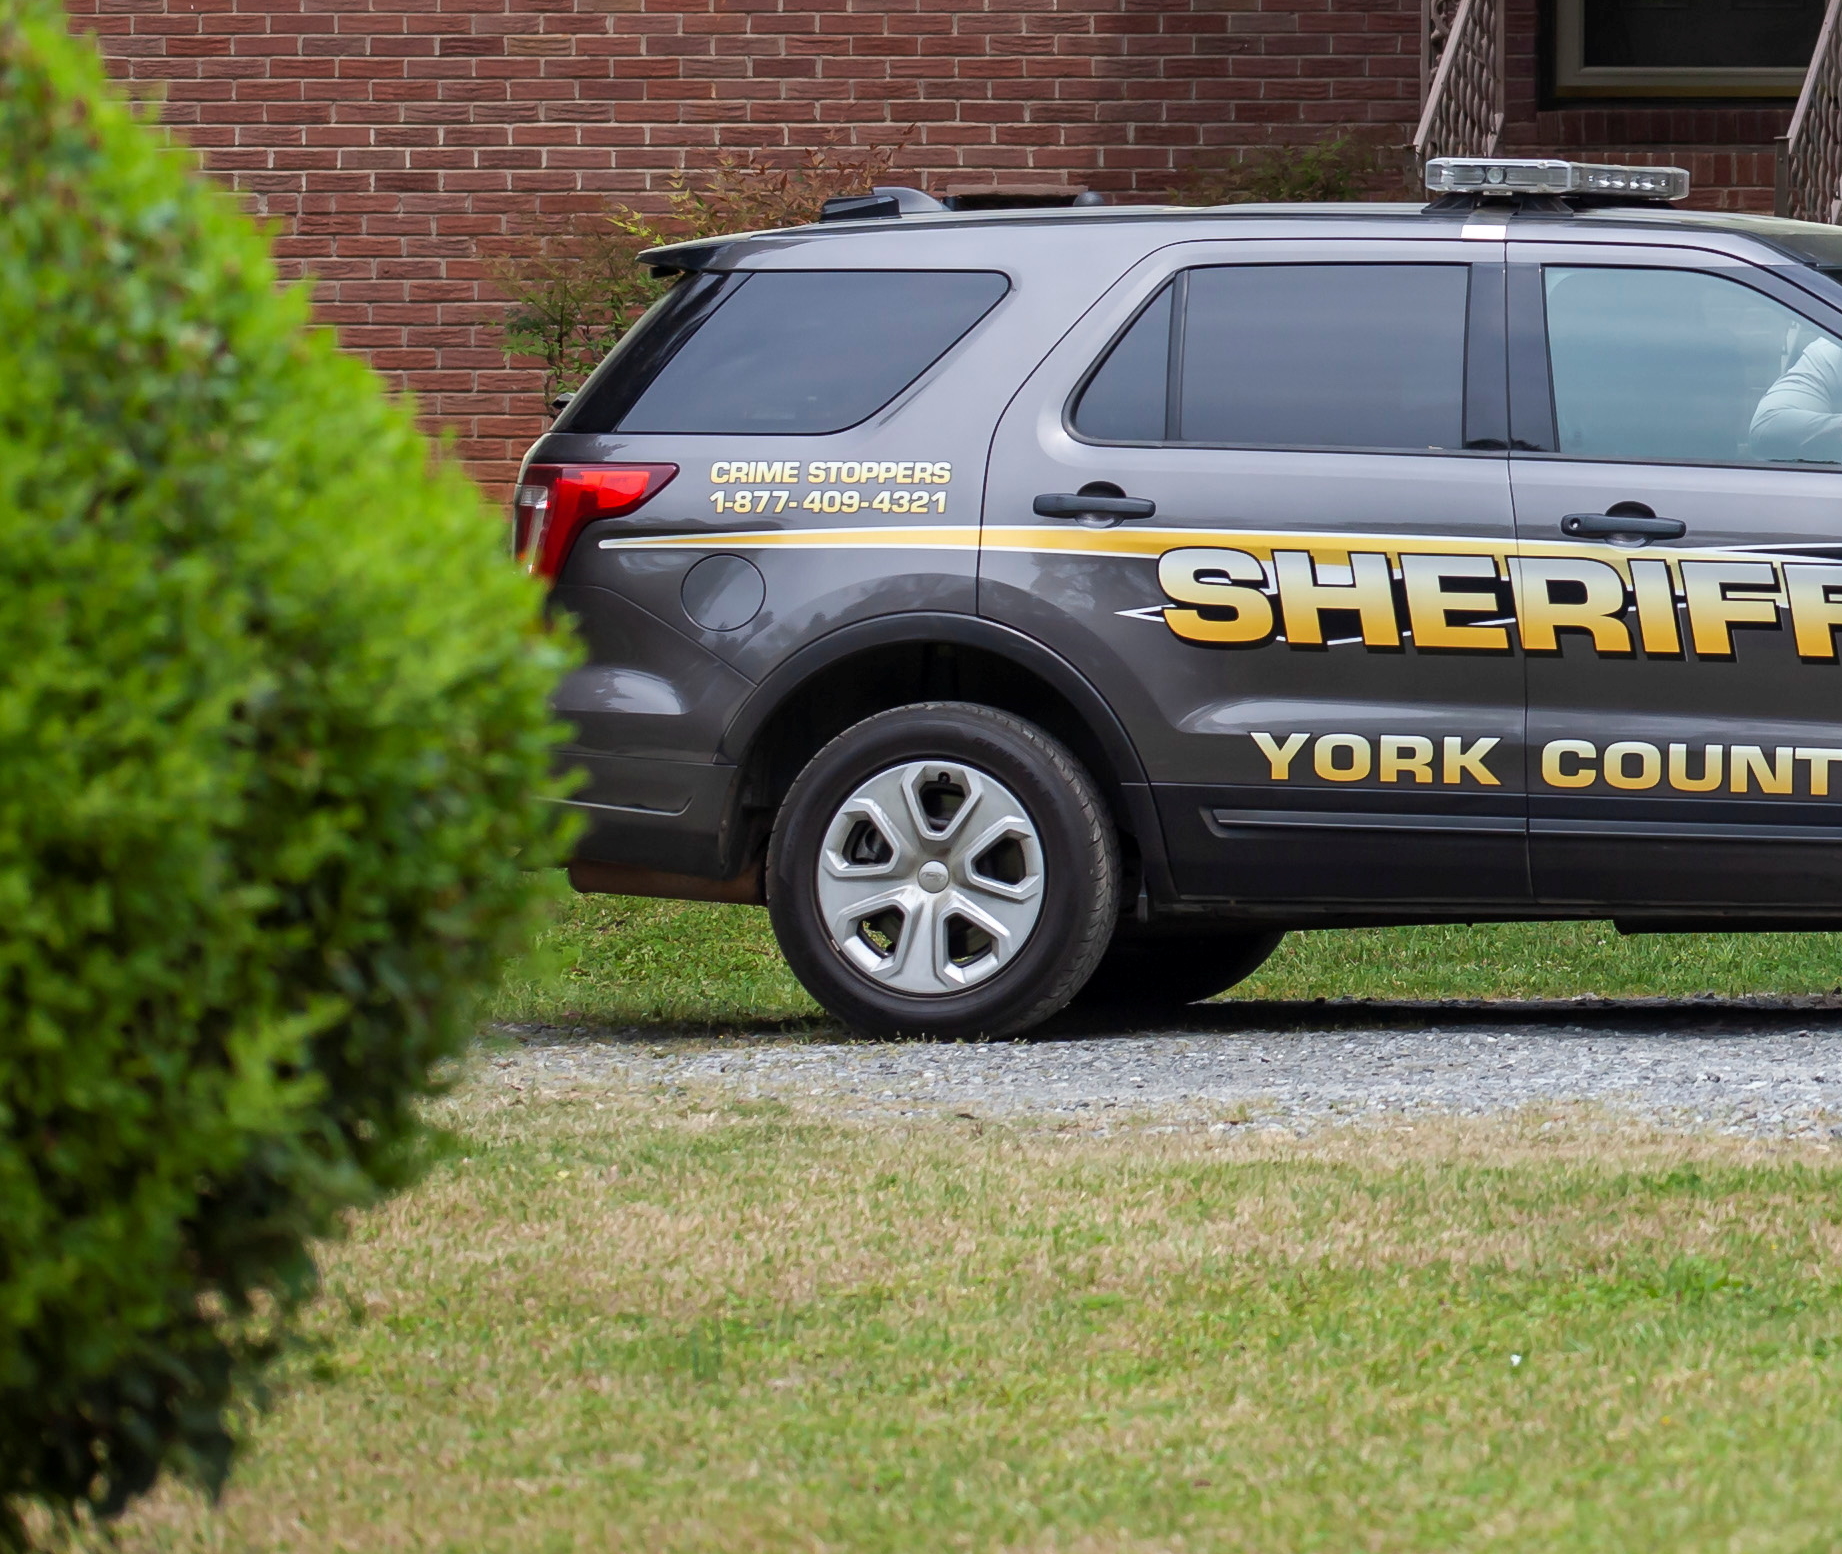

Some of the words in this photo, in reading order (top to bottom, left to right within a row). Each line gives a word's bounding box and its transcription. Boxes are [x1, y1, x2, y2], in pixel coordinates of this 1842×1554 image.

[710, 461, 801, 484] CRIME
[807, 461, 952, 484] STOPPERS
[1250, 731, 1502, 786] YORK
